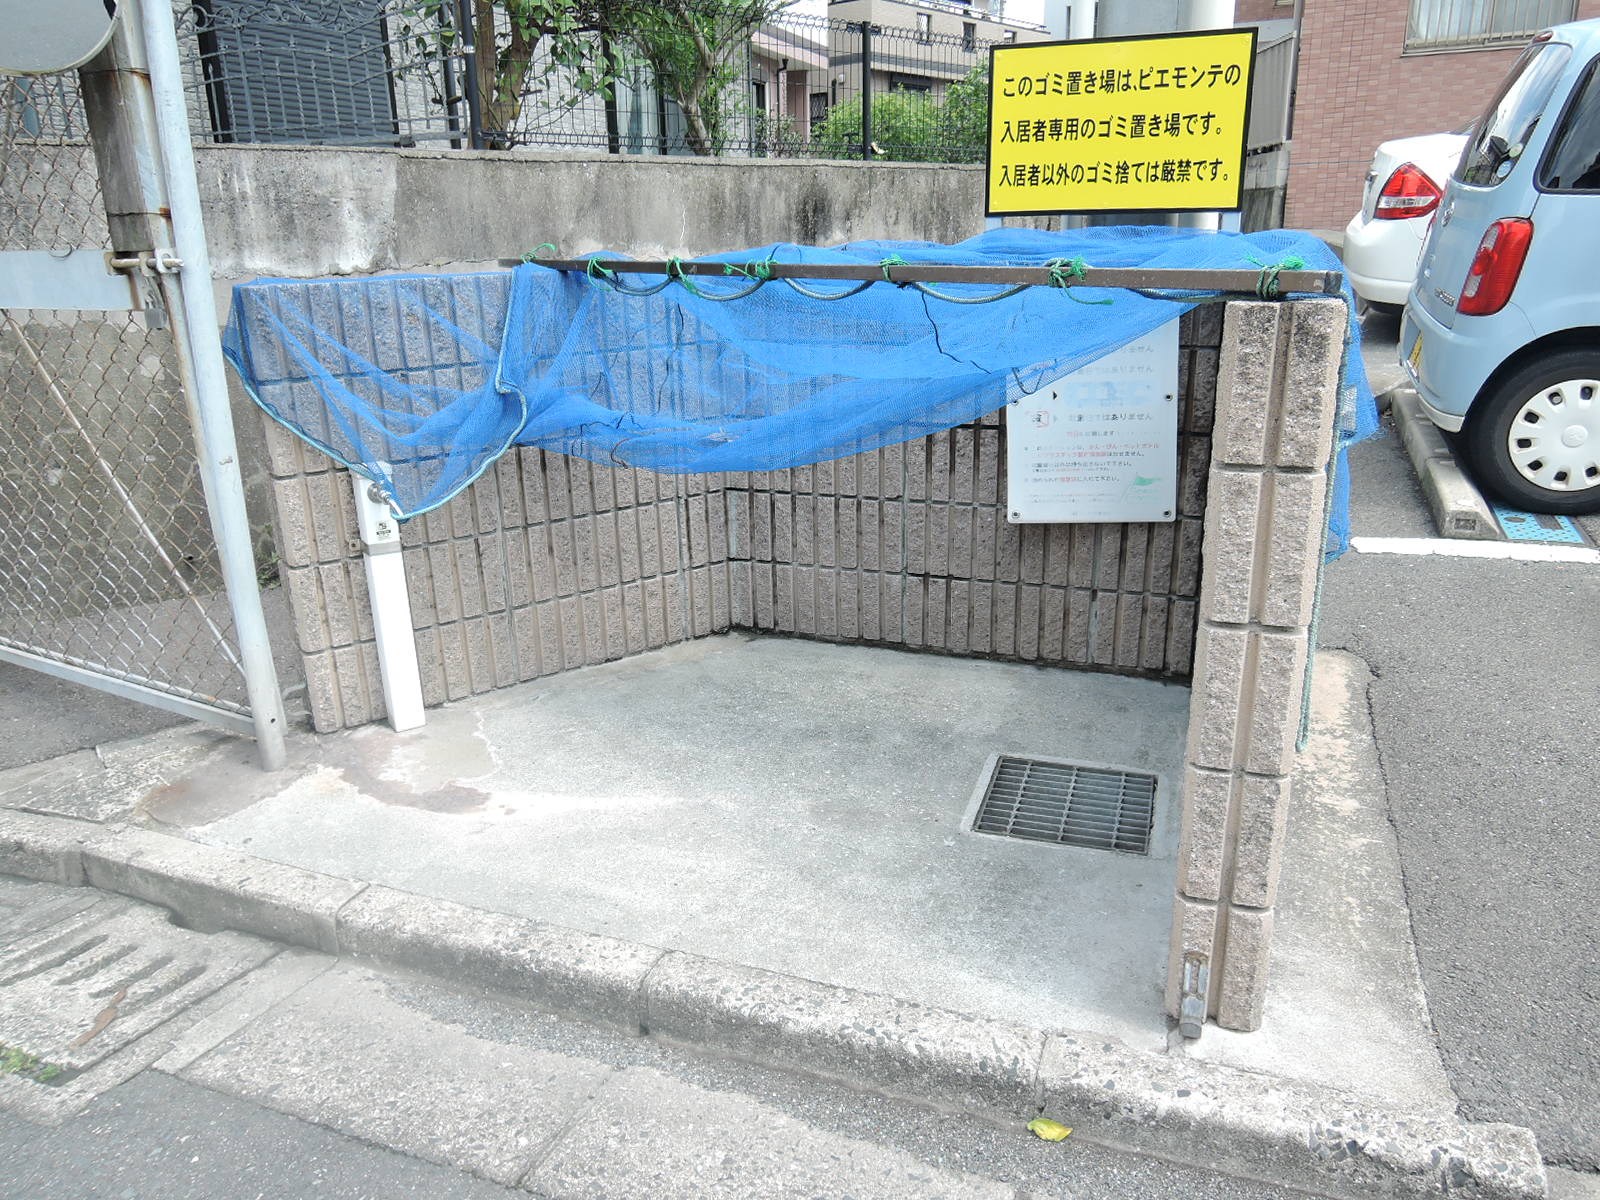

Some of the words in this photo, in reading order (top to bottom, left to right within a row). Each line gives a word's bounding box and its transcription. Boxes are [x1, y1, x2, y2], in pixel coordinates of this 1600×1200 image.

[1003, 64, 1241, 98] このゴミ置き場は、ピエモンテの
[1000, 111, 1223, 143] 入居者専用のゴミ置き場です。
[998, 158, 1230, 187] 入居者以外のゴミ捨ては厳禁です。
